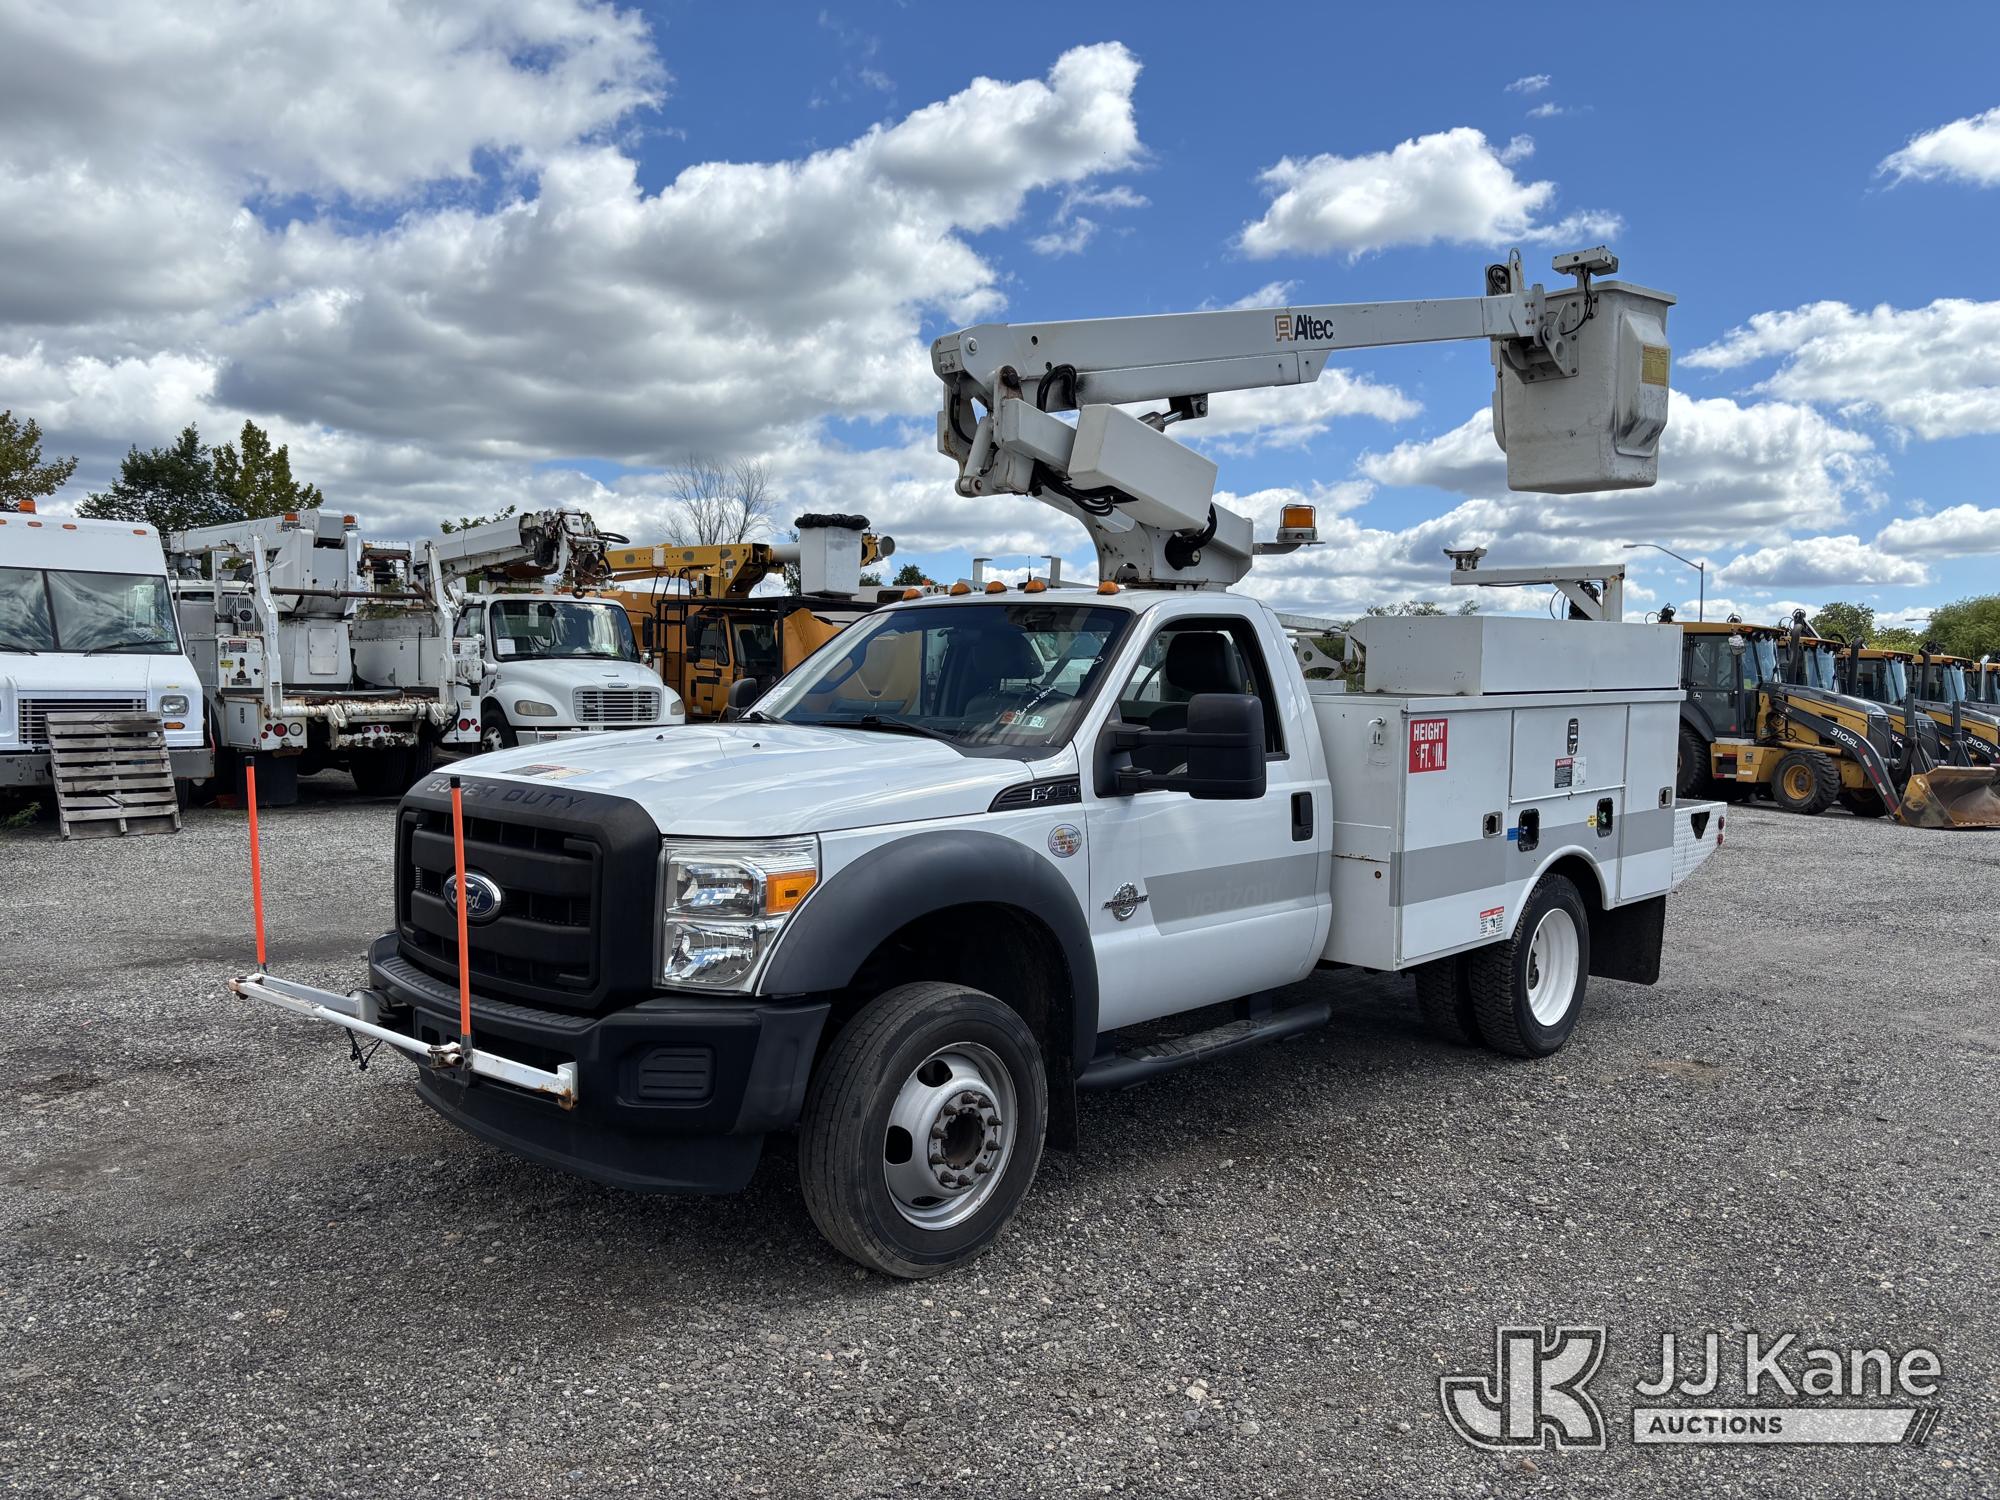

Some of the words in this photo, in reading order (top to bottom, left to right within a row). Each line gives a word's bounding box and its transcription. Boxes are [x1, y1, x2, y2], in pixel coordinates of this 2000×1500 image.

[1294, 314, 1334, 341] Altec
[1413, 722, 1445, 742] HEIGHT
[1830, 727, 1858, 749] 310SL
[1966, 736, 1992, 754] 310SL
[502, 788, 587, 809] DUTY
